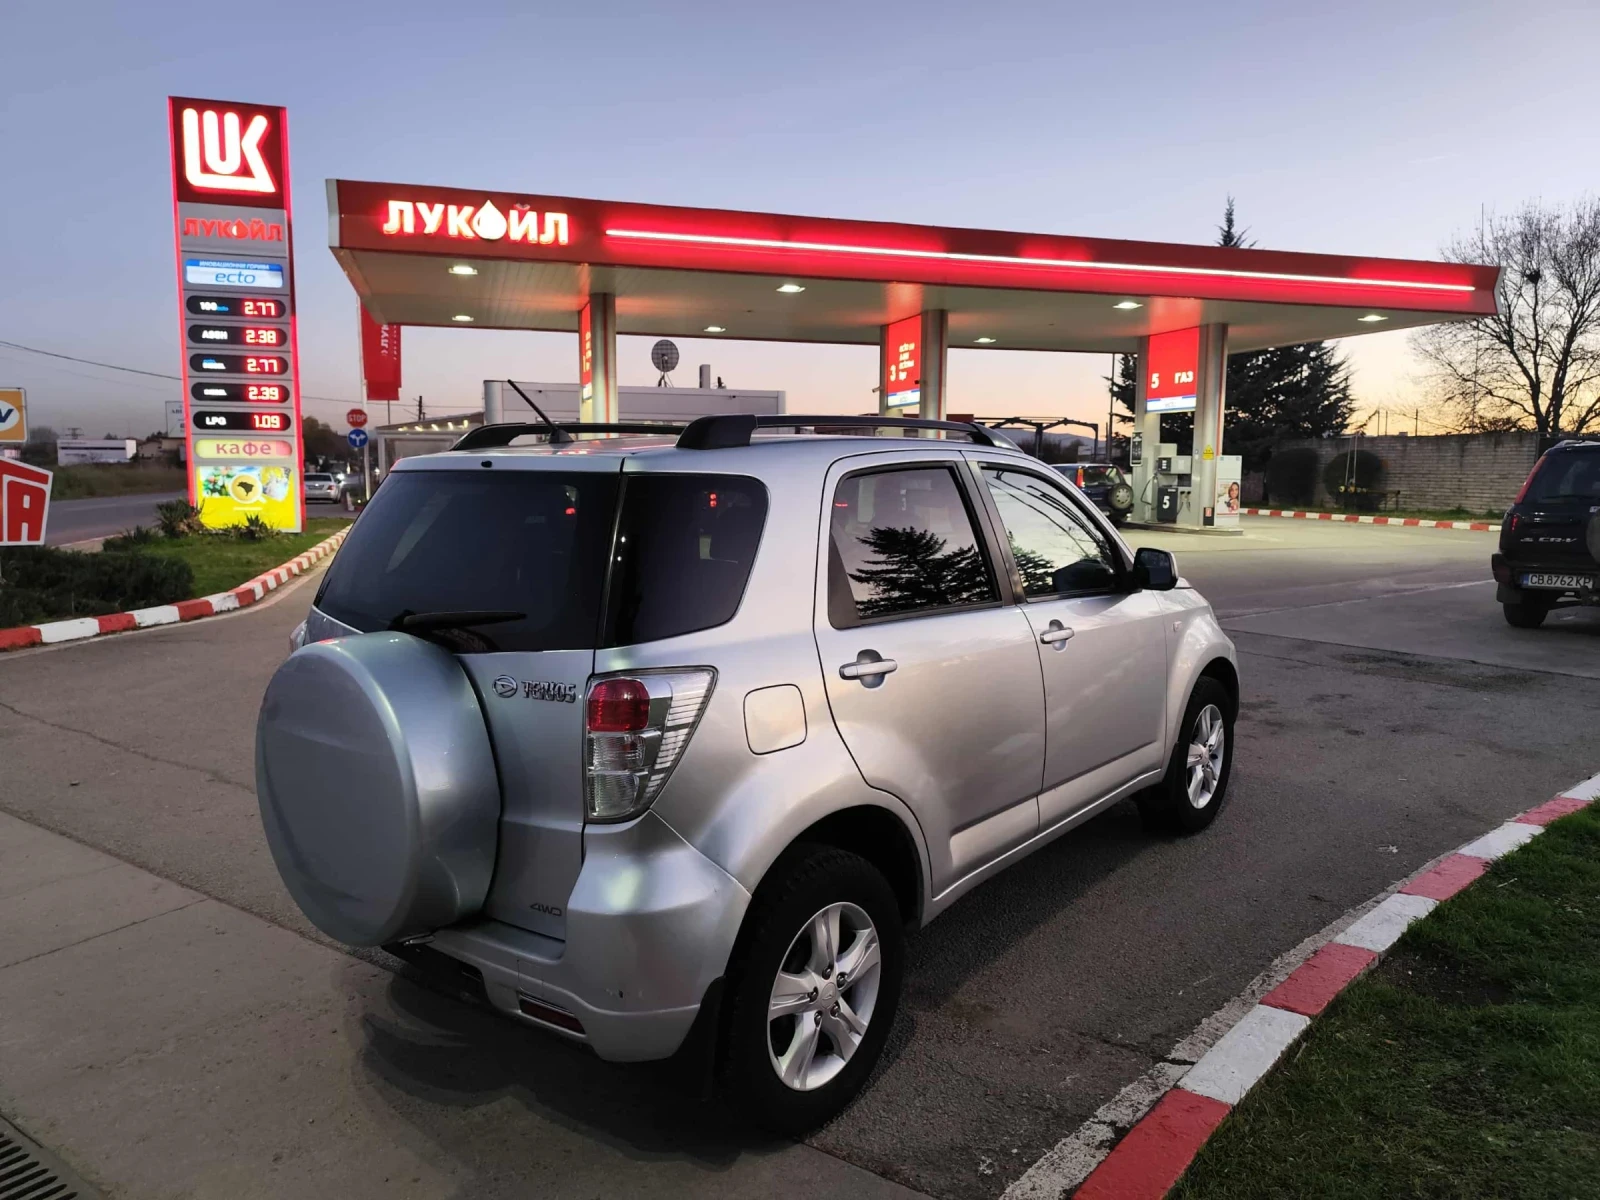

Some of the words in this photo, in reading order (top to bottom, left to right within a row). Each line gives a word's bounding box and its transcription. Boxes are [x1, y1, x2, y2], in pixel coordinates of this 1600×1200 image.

[183, 108, 276, 192] LUK
[383, 199, 569, 245] ЛУКОЙЛ
[215, 271, 256, 284] ecto
[244, 301, 275, 316] 2.77
[246, 329, 276, 343] 2.38
[247, 358, 278, 372] 2.77
[890, 364, 896, 382] 3
[1151, 372, 1160, 389] 5
[1174, 370, 1194, 384] ГАЗ
[248, 386, 279, 400] 2.39
[205, 416, 227, 426] LPG
[254, 415, 280, 428] 1.09
[348, 414, 367, 422] STOP
[216, 441, 271, 456] кафе
[1162, 496, 1170, 509] 5
[530, 903, 563, 917] 4WD
